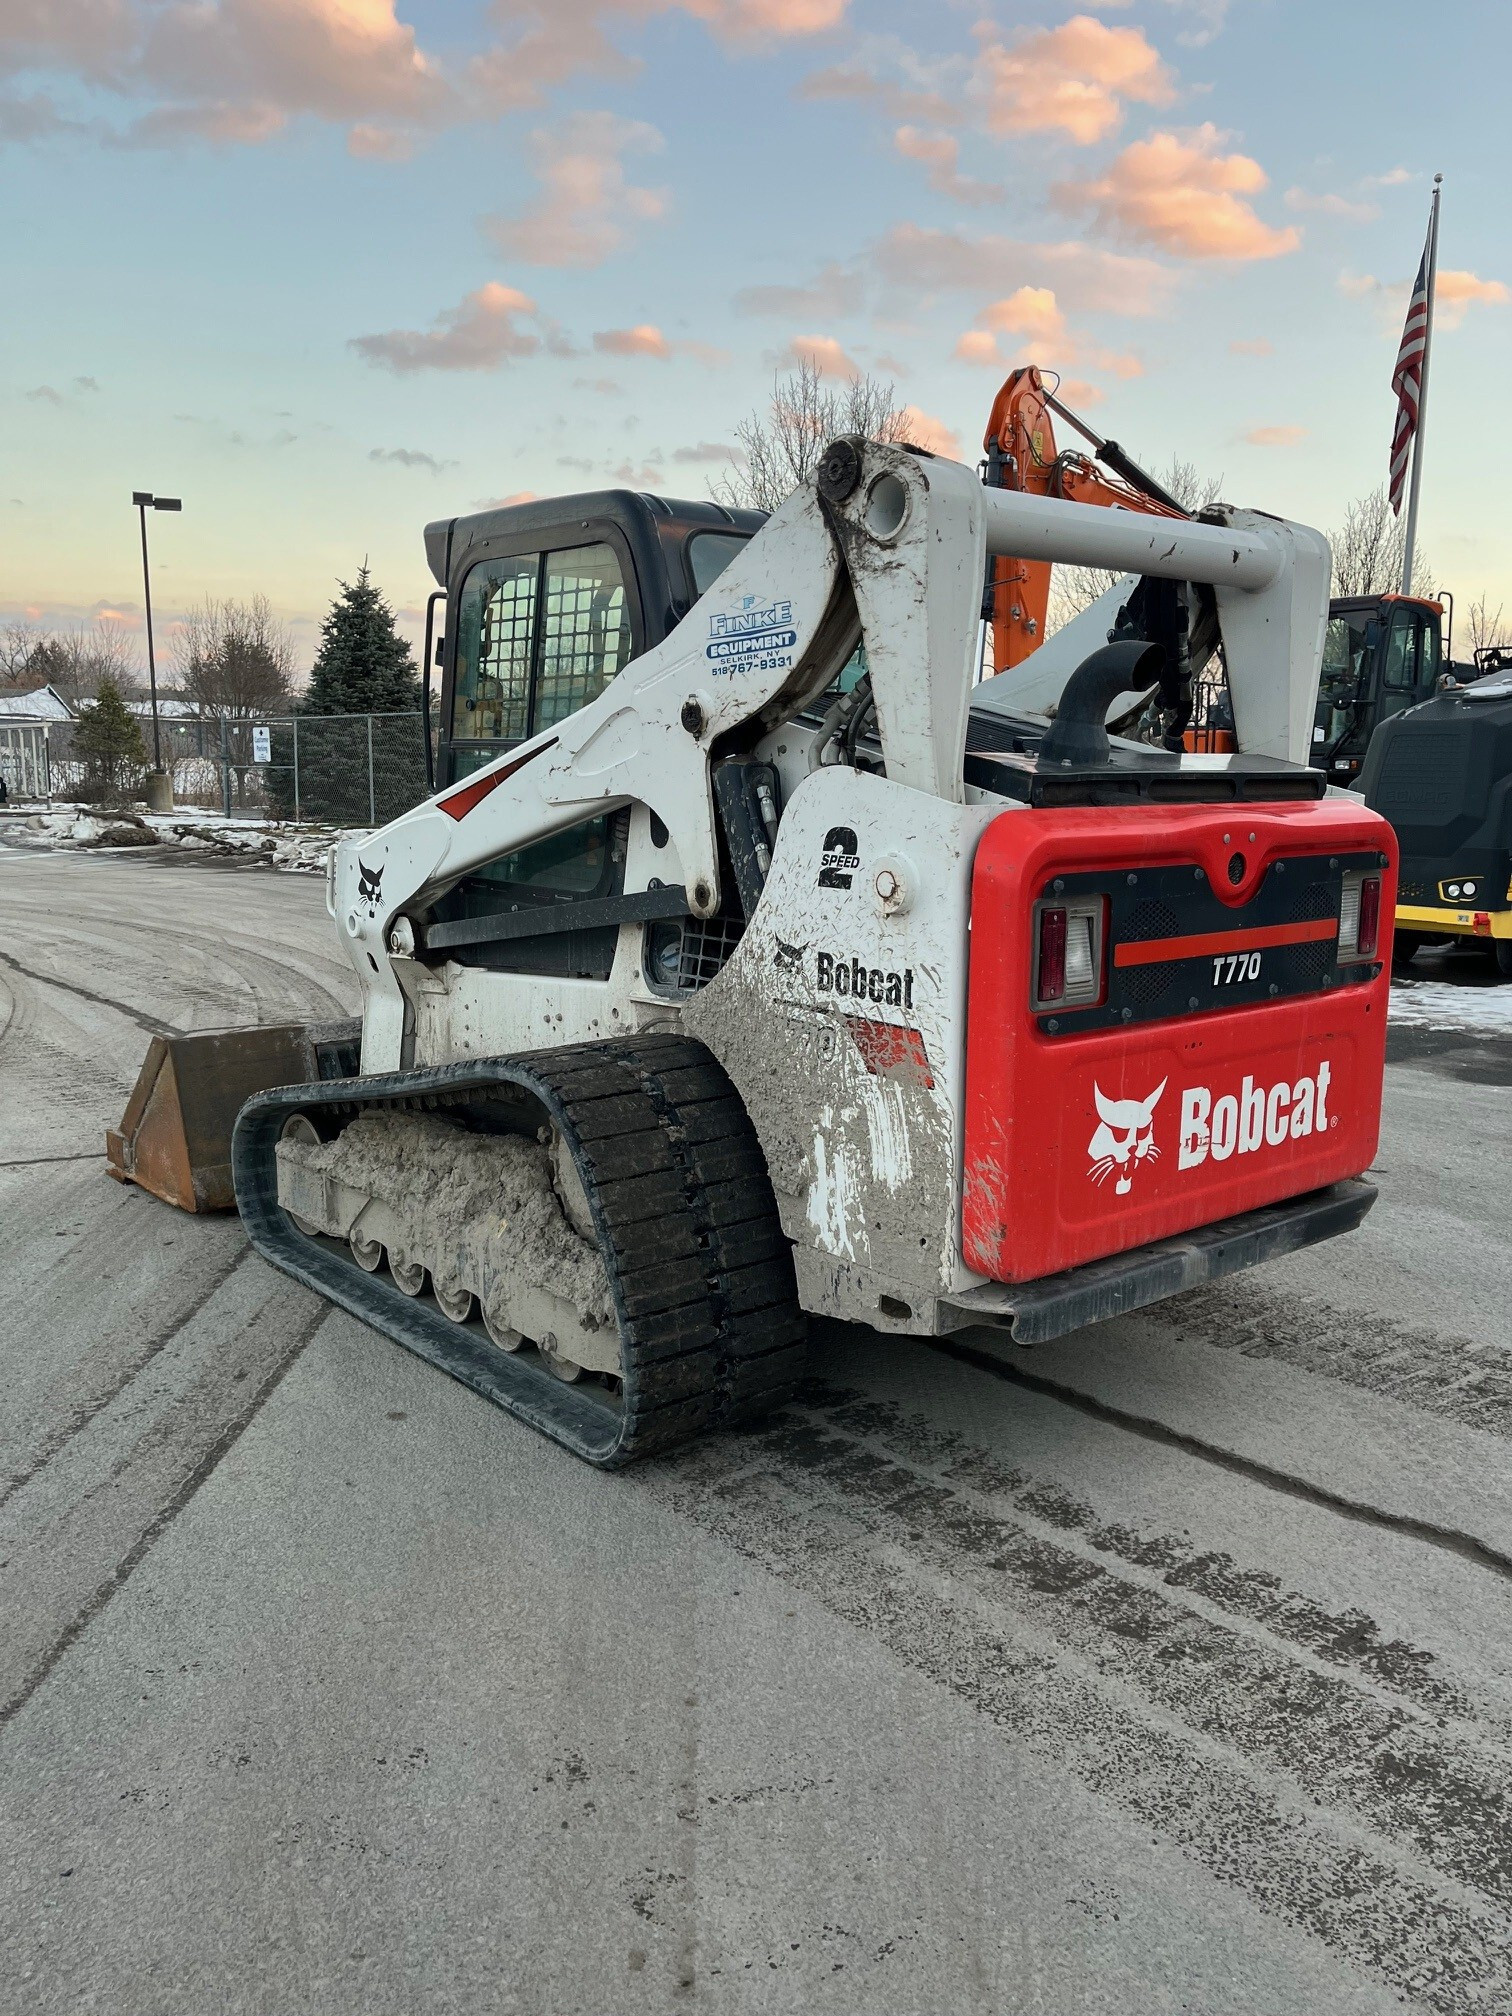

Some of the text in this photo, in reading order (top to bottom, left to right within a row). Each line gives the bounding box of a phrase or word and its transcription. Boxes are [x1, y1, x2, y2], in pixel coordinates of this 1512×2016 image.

[709, 600, 792, 637] FINKE
[710, 632, 792, 657] EQUIPMENT
[817, 826, 859, 890] 2
[821, 853, 860, 869] SPEED
[817, 951, 914, 1009] Bobcat
[1212, 952, 1262, 986] T770
[1177, 1060, 1331, 1171] Bobcat
